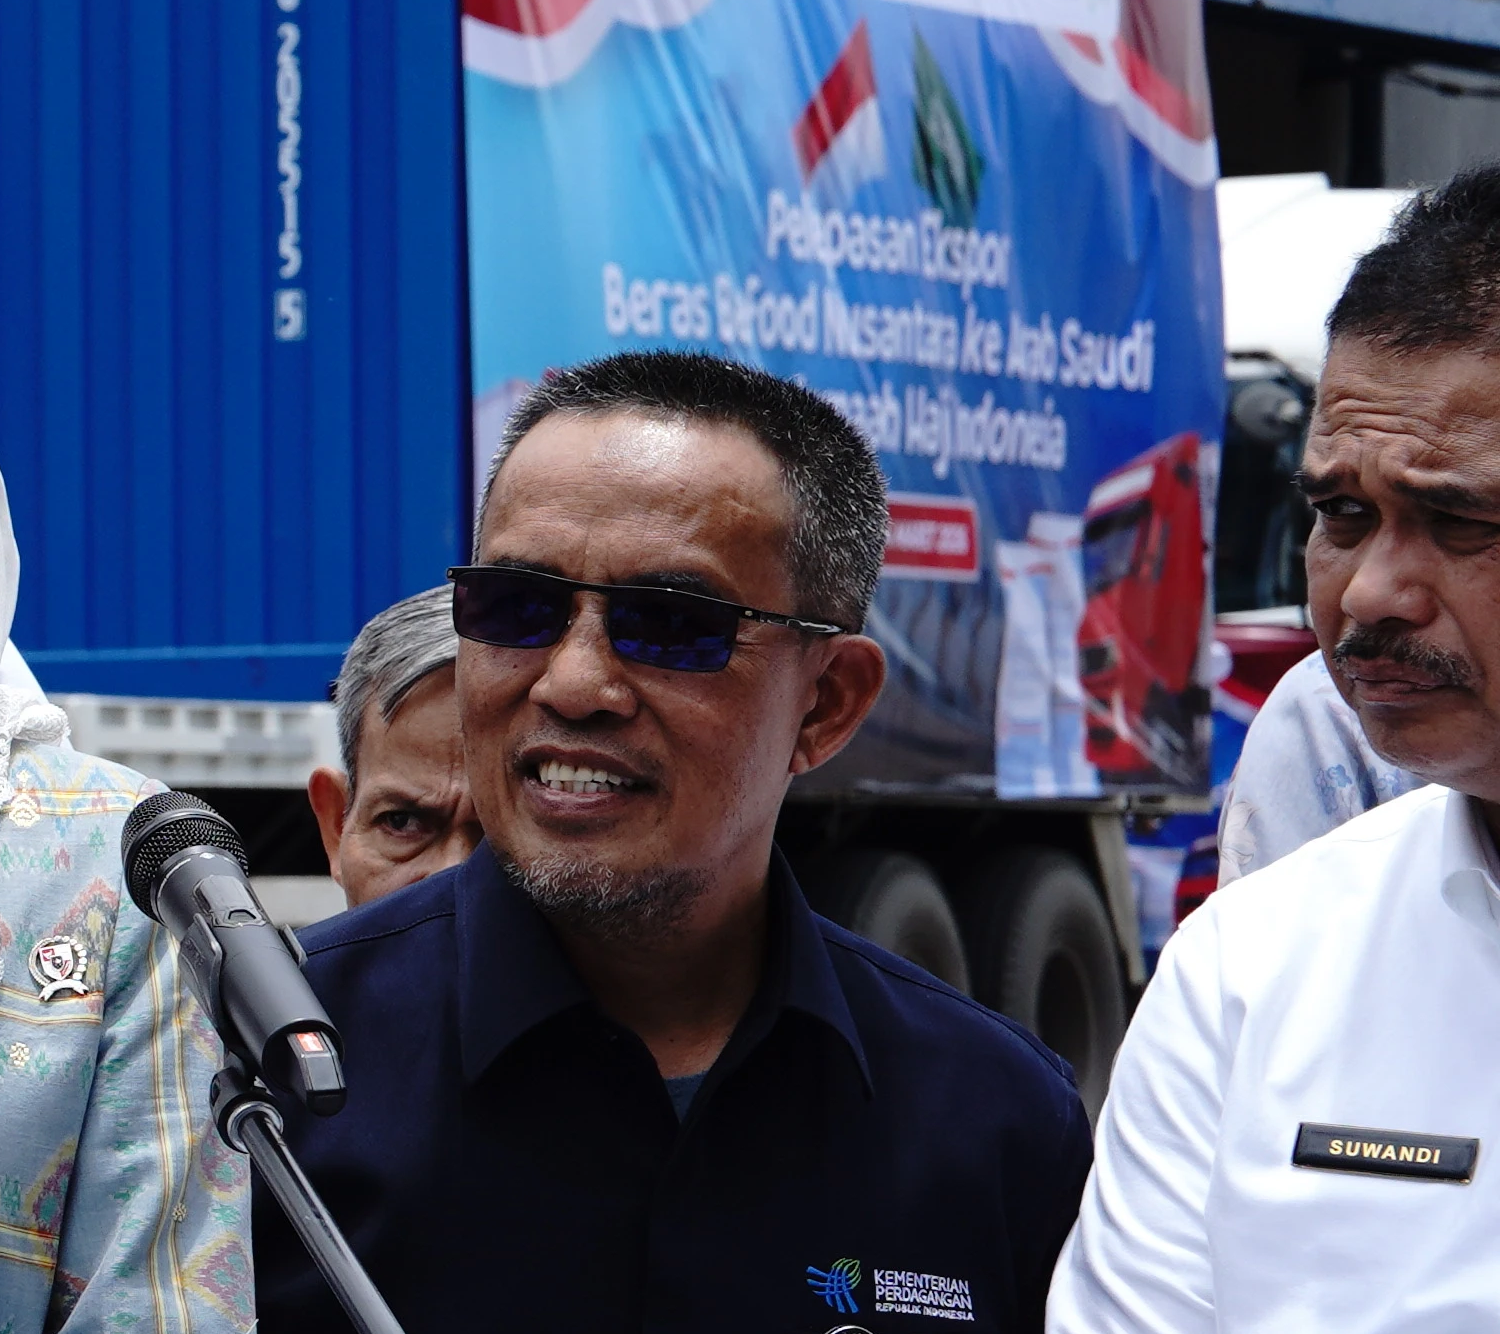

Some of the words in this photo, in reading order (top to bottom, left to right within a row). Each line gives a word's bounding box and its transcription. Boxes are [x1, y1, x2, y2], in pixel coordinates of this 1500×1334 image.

[276, 22, 302, 280] 205515
[276, 290, 303, 340] 5
[603, 263, 710, 337] Beras
[961, 302, 1002, 371] ke
[1060, 316, 1155, 393] Saudi
[1329, 1139, 1441, 1164] SUWANDI
[873, 1269, 970, 1295] KEMENTERIAN
[875, 1286, 973, 1310] PERDAGANGAN
[875, 1302, 921, 1316] REPUBLIK
[923, 1306, 975, 1321] INDONESIA
